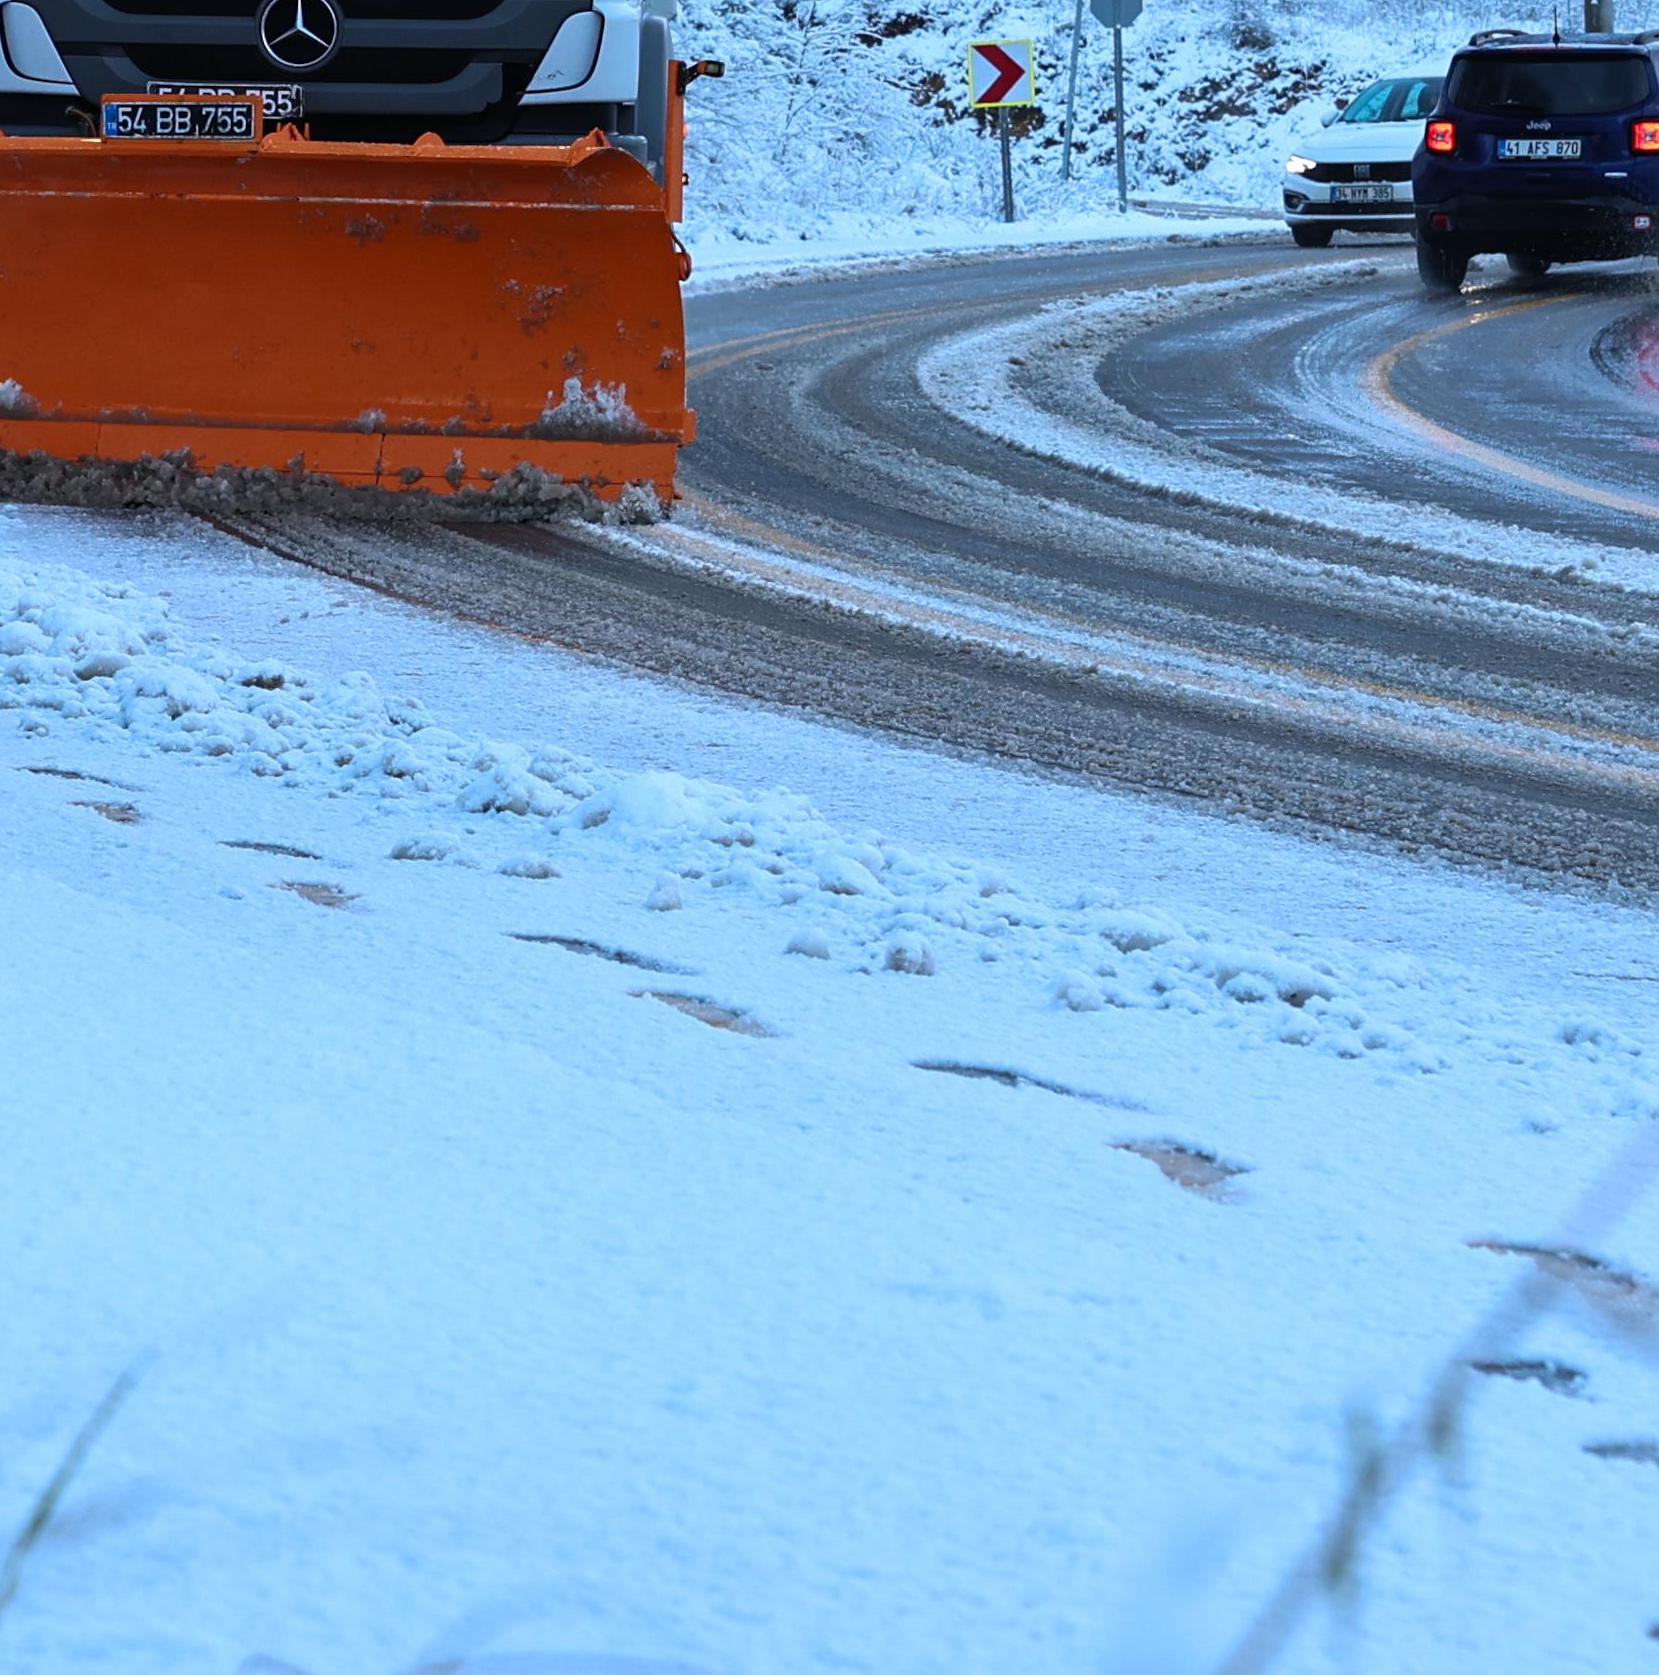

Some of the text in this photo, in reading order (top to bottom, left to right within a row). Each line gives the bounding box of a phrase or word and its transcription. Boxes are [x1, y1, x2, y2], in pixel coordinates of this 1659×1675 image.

[245, 89, 293, 115] 55
[107, 107, 247, 134] TR 54 BB 755
[1526, 120, 1552, 131] Jeep
[1506, 141, 1579, 155] 41 AFS 870
